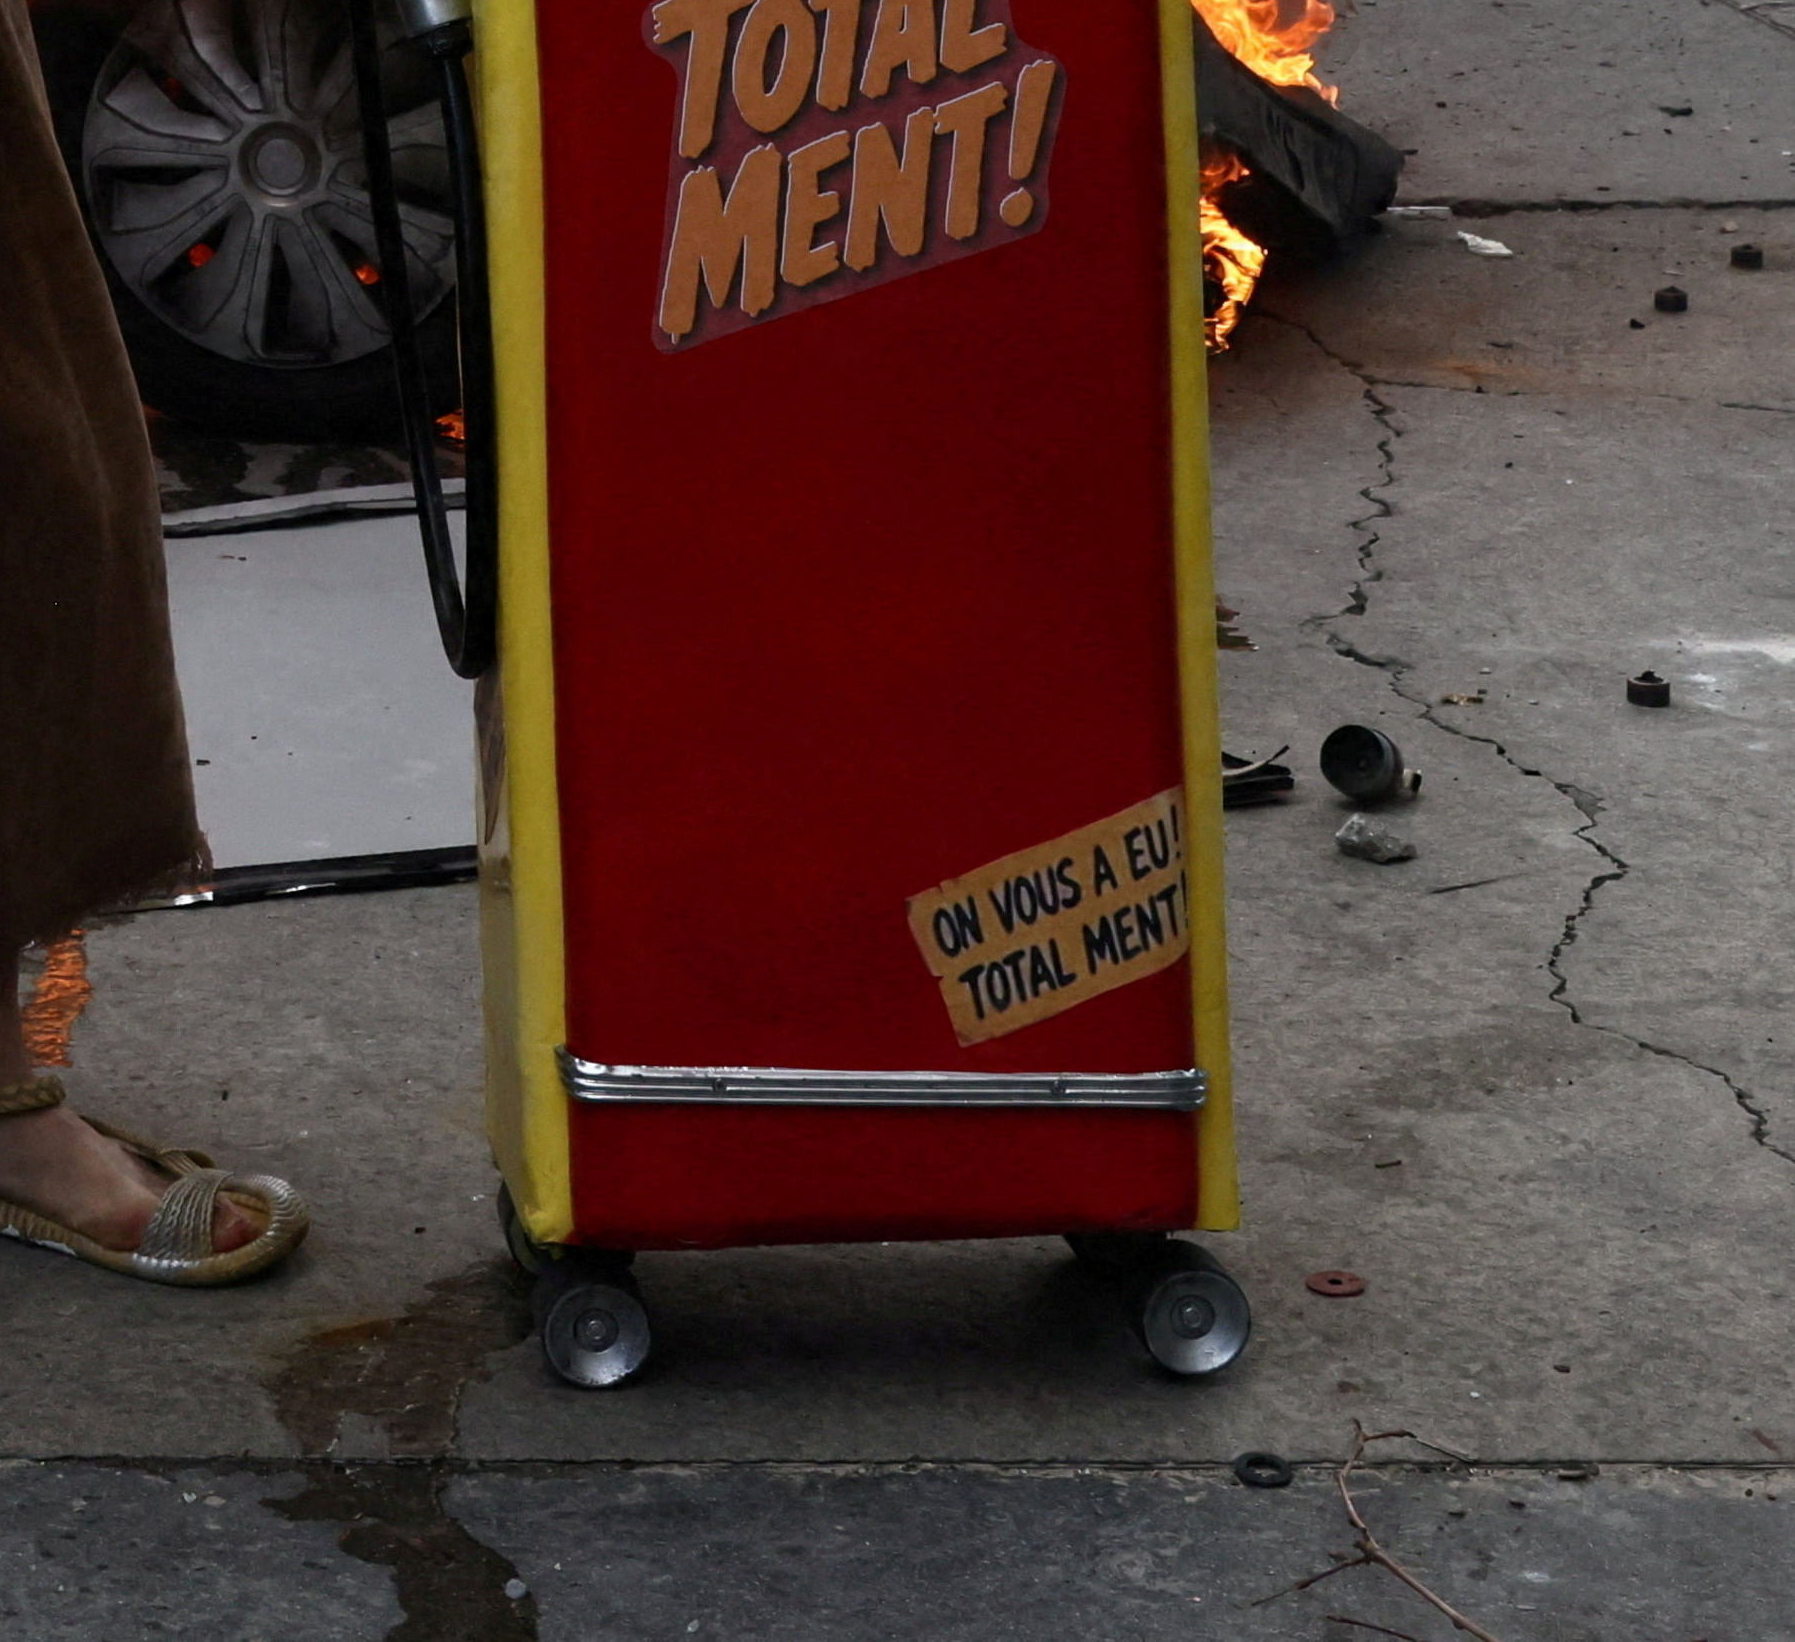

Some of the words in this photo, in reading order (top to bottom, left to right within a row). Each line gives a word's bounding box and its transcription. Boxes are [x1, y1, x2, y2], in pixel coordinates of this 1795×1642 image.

[659, 59, 1056, 344] MENT!
[932, 896, 984, 957] ON
[989, 857, 1081, 934] VOUS
[1093, 844, 1118, 896] A
[1124, 804, 1181, 881] EU!
[959, 938, 1077, 1020] TOTAL
